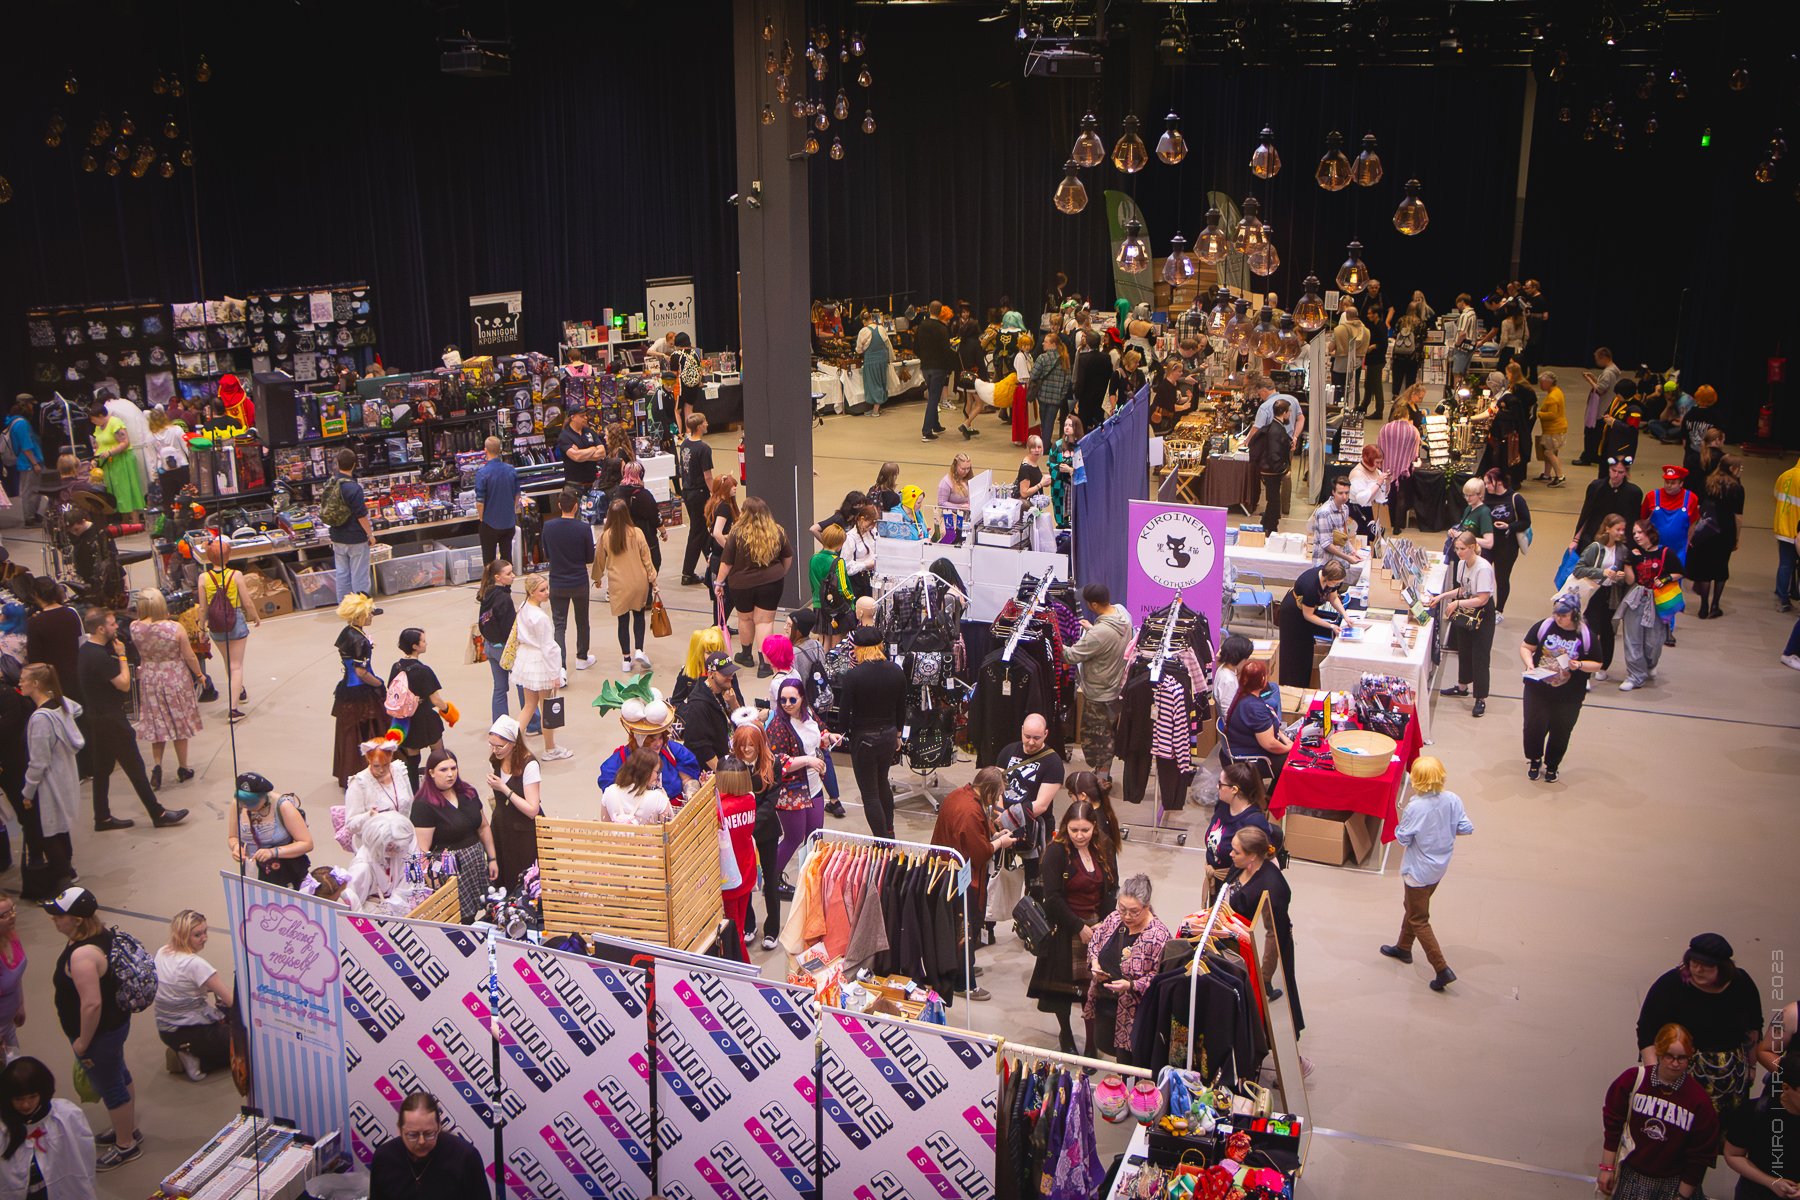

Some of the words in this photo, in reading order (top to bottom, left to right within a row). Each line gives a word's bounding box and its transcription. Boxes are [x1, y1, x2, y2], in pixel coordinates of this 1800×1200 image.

[479, 334, 518, 345] KPOPSTORE
[481, 328, 514, 338] ONNIGOM
[653, 319, 691, 327] KPOPSTORE
[656, 312, 687, 320] ONNIGOM
[1140, 513, 1212, 546] KUROINEKO
[1153, 575, 1197, 588] CLOTHING
[260, 909, 319, 953] Talking
[284, 940, 294, 954] to
[355, 918, 422, 991] SHOP
[375, 919, 450, 989] IME
[268, 951, 320, 980] myself
[340, 941, 406, 1031] NIME
[521, 967, 588, 1047] SHOP
[528, 949, 616, 1046] ANIME
[689, 970, 781, 1070] ANIME
[682, 990, 751, 1071] SHOP
[842, 1016, 915, 1100] SHOP
[865, 1019, 949, 1099] IME
[426, 1044, 492, 1120] SHOP
[760, 1100, 841, 1179] ANIE
[804, 1086, 863, 1141] SOP
[1633, 1093, 1695, 1131] ONTAN
[549, 1135, 595, 1189] SHO
[752, 1126, 802, 1185] SHO
